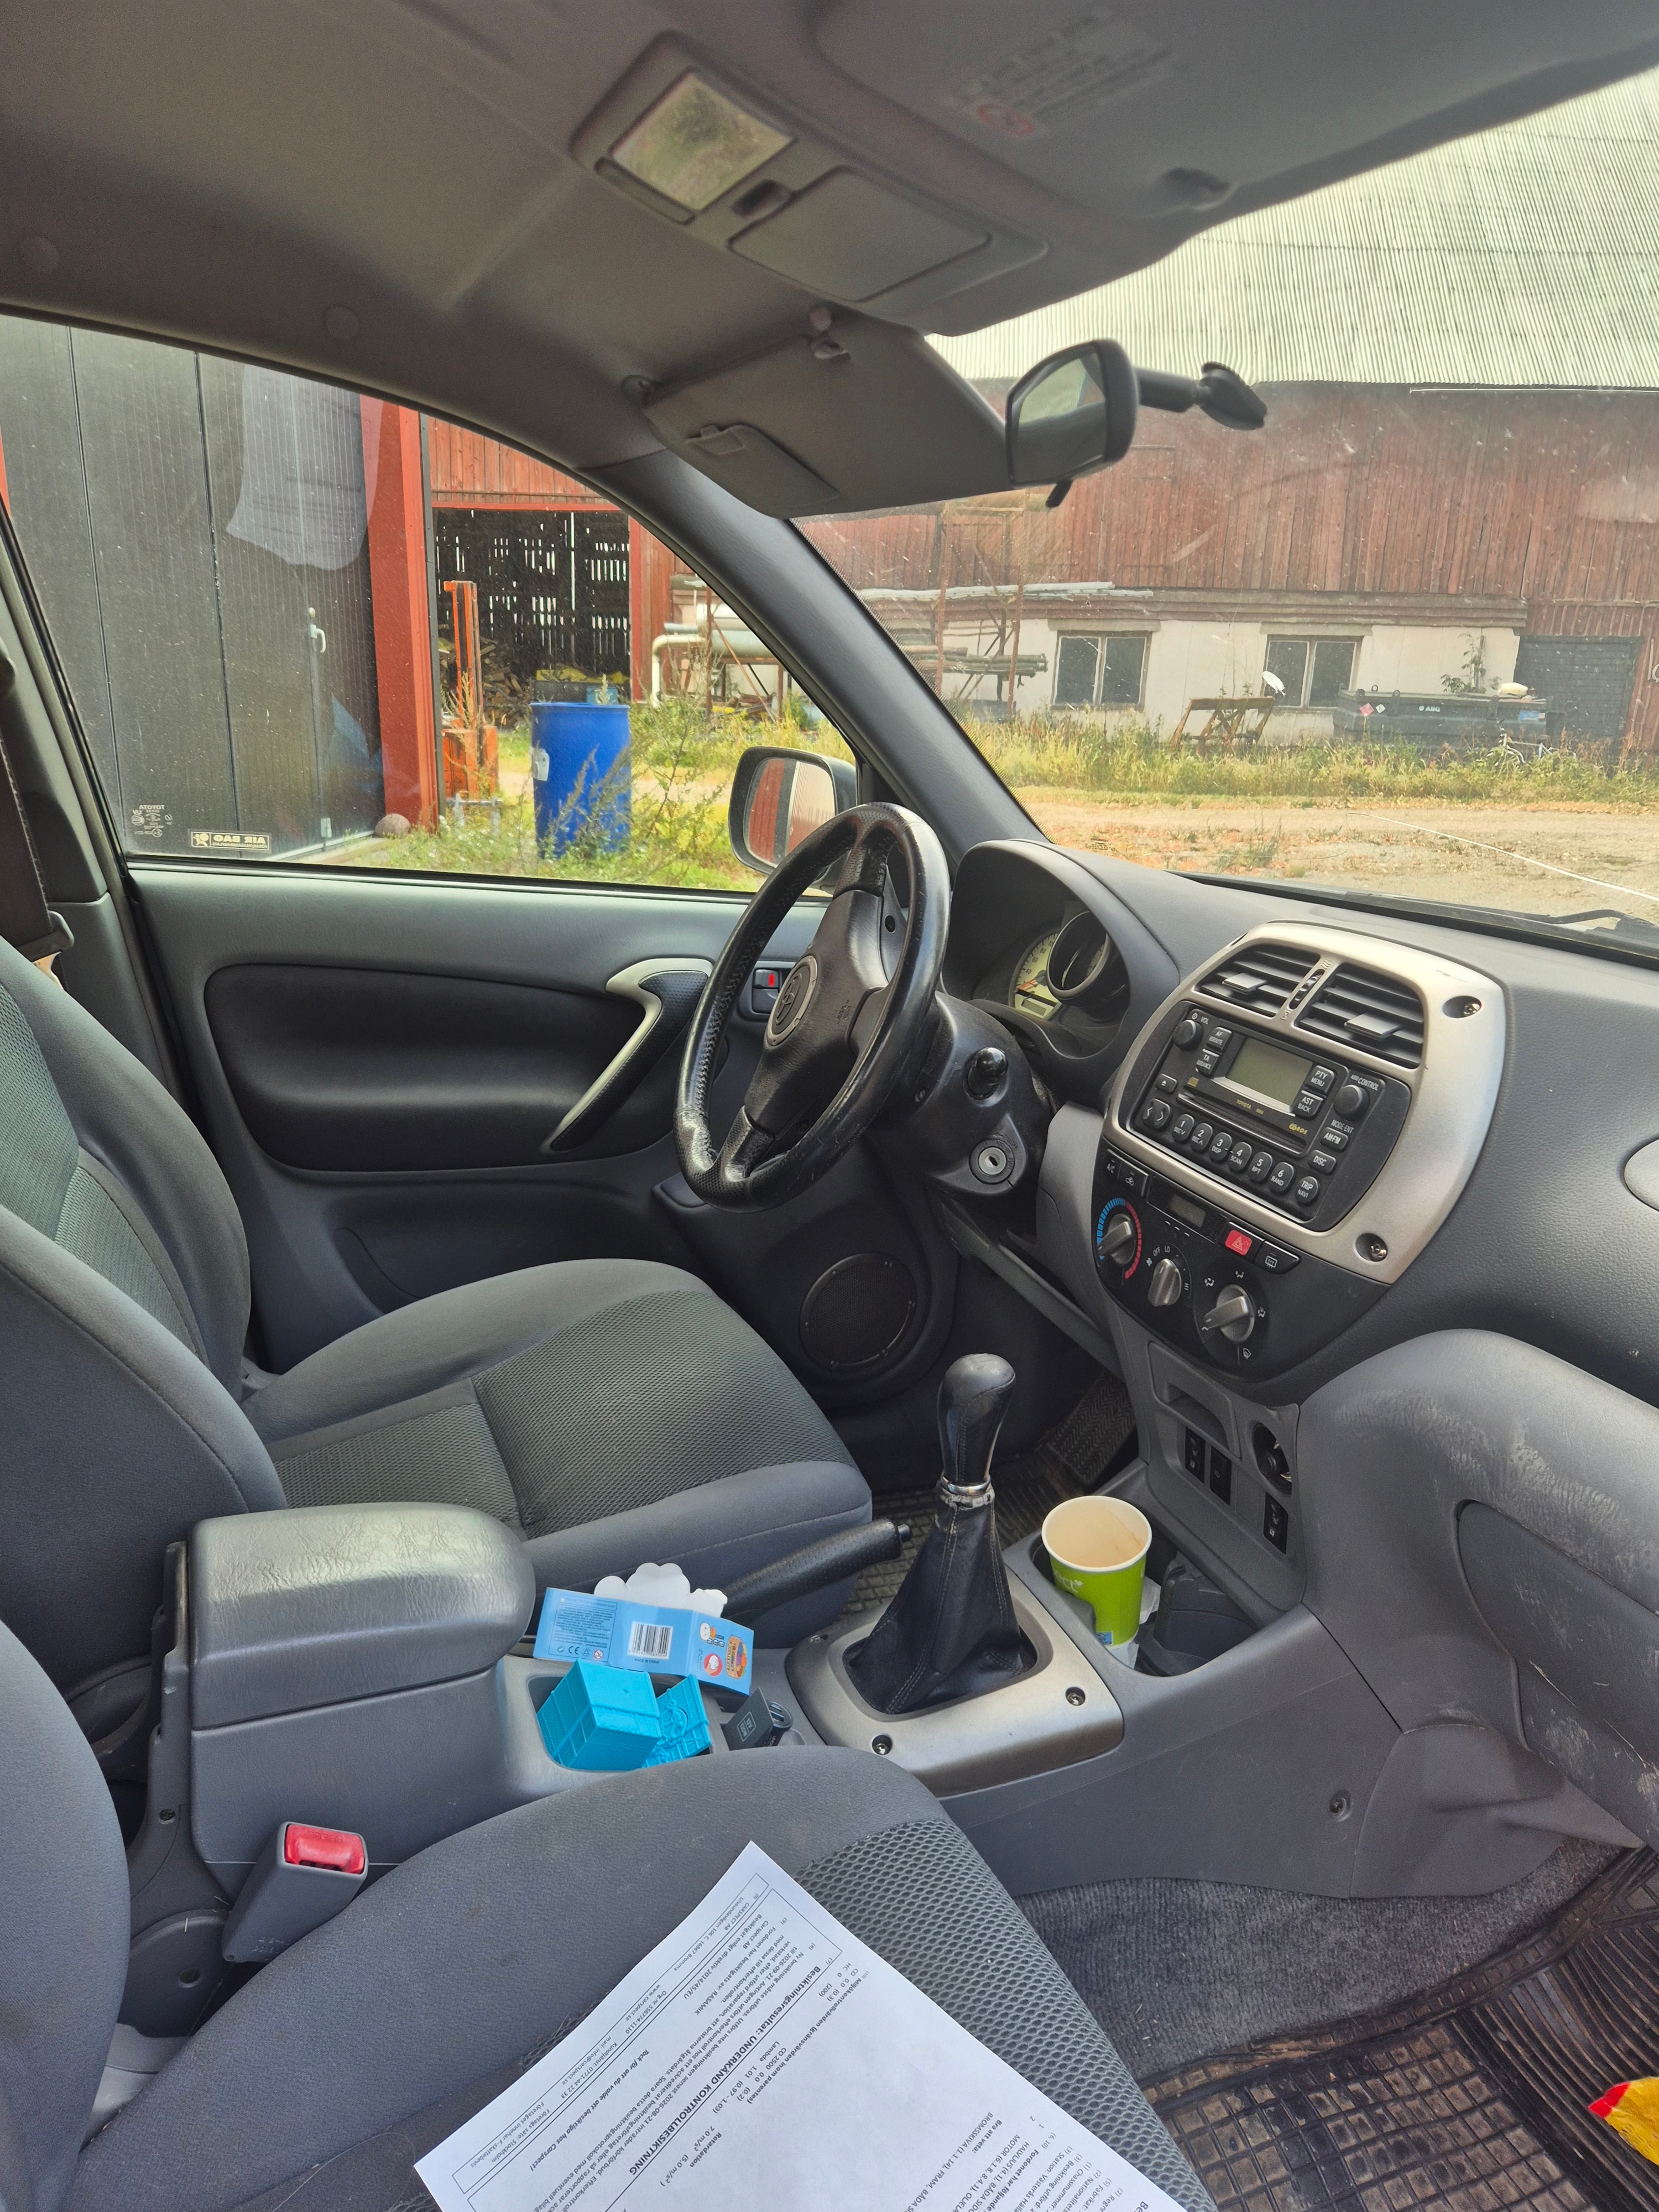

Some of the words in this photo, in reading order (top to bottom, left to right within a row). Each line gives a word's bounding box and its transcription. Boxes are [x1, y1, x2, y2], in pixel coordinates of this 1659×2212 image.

[1311, 1077, 1325, 1087] MENU
[1314, 1071, 1328, 1079] PTY
[1358, 1077, 1380, 1091] CONTROL
[1236, 1099, 1251, 1109] TOYOTA
[1297, 1103, 1311, 1113] BACK
[1301, 1096, 1314, 1105] AST
[1107, 1163, 1115, 1173] A/C
[1230, 1155, 1243, 1165] SCAN
[1313, 1155, 1327, 1166] DISC
[1251, 1166, 1261, 1175] RPT
[1278, 1169, 1284, 1177] 6
[1271, 1176, 1284, 1186] RAND
[1301, 1180, 1313, 1191] TRIP
[1297, 1189, 1308, 1199] NAVI
[730, 1902, 750, 1926] CARSPECT
[707, 1927, 718, 1937] 106
[723, 1922, 732, 1932] AB
[739, 1913, 763, 1938] Besiktigat
[748, 1919, 769, 1942] Carspect
[691, 1939, 705, 1955] 16867
[726, 1937, 742, 1952] enligt
[742, 1939, 751, 1950] AB
[754, 1926, 777, 1949] Fordonet
[710, 1950, 729, 1971] direktiv
[747, 1947, 758, 1958] har
[789, 1946, 798, 1955] till
[795, 1951, 805, 1960] Ny
[673, 1952, 693, 1972] Bromma
[723, 1955, 750, 1984] besiktigats
[773, 1958, 799, 1984] besiktning
[683, 1968, 713, 2000] 2014/45/EU
[716, 1981, 726, 1991] av:
[743, 1980, 766, 2005] Antingen
[759, 1981, 776, 1999] måste
[624, 1984, 661, 2022] www.carspect.se
[693, 1989, 719, 2016] RASAMIK
[742, 1997, 762, 2017] utföras.
[755, 1965, 822, 2036] Besiktningsresultat:
[815, 1977, 862, 2028] Miljökontrollvärden
[624, 2004, 654, 2035] 556774-1110
[729, 2002, 746, 2020] utförs
[700, 2017, 732, 2052] efterkontroll
[726, 2017, 744, 2034] Utförs
[598, 2035, 612, 2049] mail:
[716, 2032, 730, 2045] inte
[784, 2026, 818, 2063] (gränsvärden
[591, 2041, 618, 2068] Kundtjänst:
[636, 2048, 650, 2063] Tack
[686, 2043, 720, 2077] besiktningen
[691, 2048, 703, 2060] hos
[710, 2035, 758, 2085] UNDERKÄND
[759, 2040, 781, 2063] Lambda
[620, 2068, 630, 2079] att
[629, 2058, 639, 2071] för
[683, 2058, 693, 2069] ett
[744, 2065, 758, 2079] 1.01
[573, 2066, 594, 2087] 0771-44
[613, 2077, 622, 2086] du
[653, 2067, 686, 2101] ackrediterat
[671, 2075, 689, 2095] senast
[560, 2090, 569, 2100] 33
[566, 2084, 576, 2093] 22
[598, 2084, 615, 2101] valde
[729, 2079, 744, 2097] (0.97
[746, 2074, 773, 2105] parentes)
[519, 2101, 545, 2125] Företaget
[589, 2099, 600, 2110] att
[643, 2092, 674, 2125] 2026-08-21
[712, 2097, 728, 2115] 1.03)
[528, 2107, 551, 2130] Företags
[565, 2107, 592, 2135] besiktiga
[607, 2099, 657, 2150] besiktningsföretag
[991, 2119, 1003, 2131] Bra
[502, 2122, 522, 2141] innehar
[515, 2127, 530, 2141] säte:
[555, 2132, 568, 2145] hos
[623, 2122, 646, 2148] inträder
[628, 2083, 713, 2176] KONTROLLBESIKTNING
[961, 2111, 994, 2148] BROMSSKIVA
[983, 2128, 994, 2140] att
[469, 2138, 504, 2168] F-skattebevis
[491, 2138, 518, 2163] Stockholm
[688, 2131, 723, 2168] Retardation
[971, 2138, 987, 2154] veta:
[1000, 2133, 1021, 2157] MOTOR
[1005, 2141, 1030, 2169] HALVLJUS
[529, 2143, 557, 2172] Carspect!
[588, 2161, 598, 2171] så
[595, 2145, 625, 2177] körförbud.
[596, 2148, 610, 2164] eller
[941, 2146, 965, 2170] (1.1.14),
[1014, 2148, 1040, 2177] Fordonet
[1043, 2152, 1066, 2177] Station:
[925, 2169, 946, 2189] FRAM,
[969, 2173, 989, 2193] 8.4.1),
[993, 2166, 1010, 2183] (4.1),
[1006, 2174, 1019, 2188] har
[1048, 2159, 1075, 2190] Besiktning
[558, 2168, 591, 2204] rapporterar
[979, 2181, 997, 2201] BÅDA
[1025, 2174, 1049, 2200] Västerås
[1048, 2168, 1084, 2210] Chassinummer:
[910, 2188, 930, 2208] BÅDA
[986, 2185, 1010, 2212] följande
[1033, 2188, 1052, 2209] utförd:
[1081, 2184, 1104, 2210] Fabrikat:
